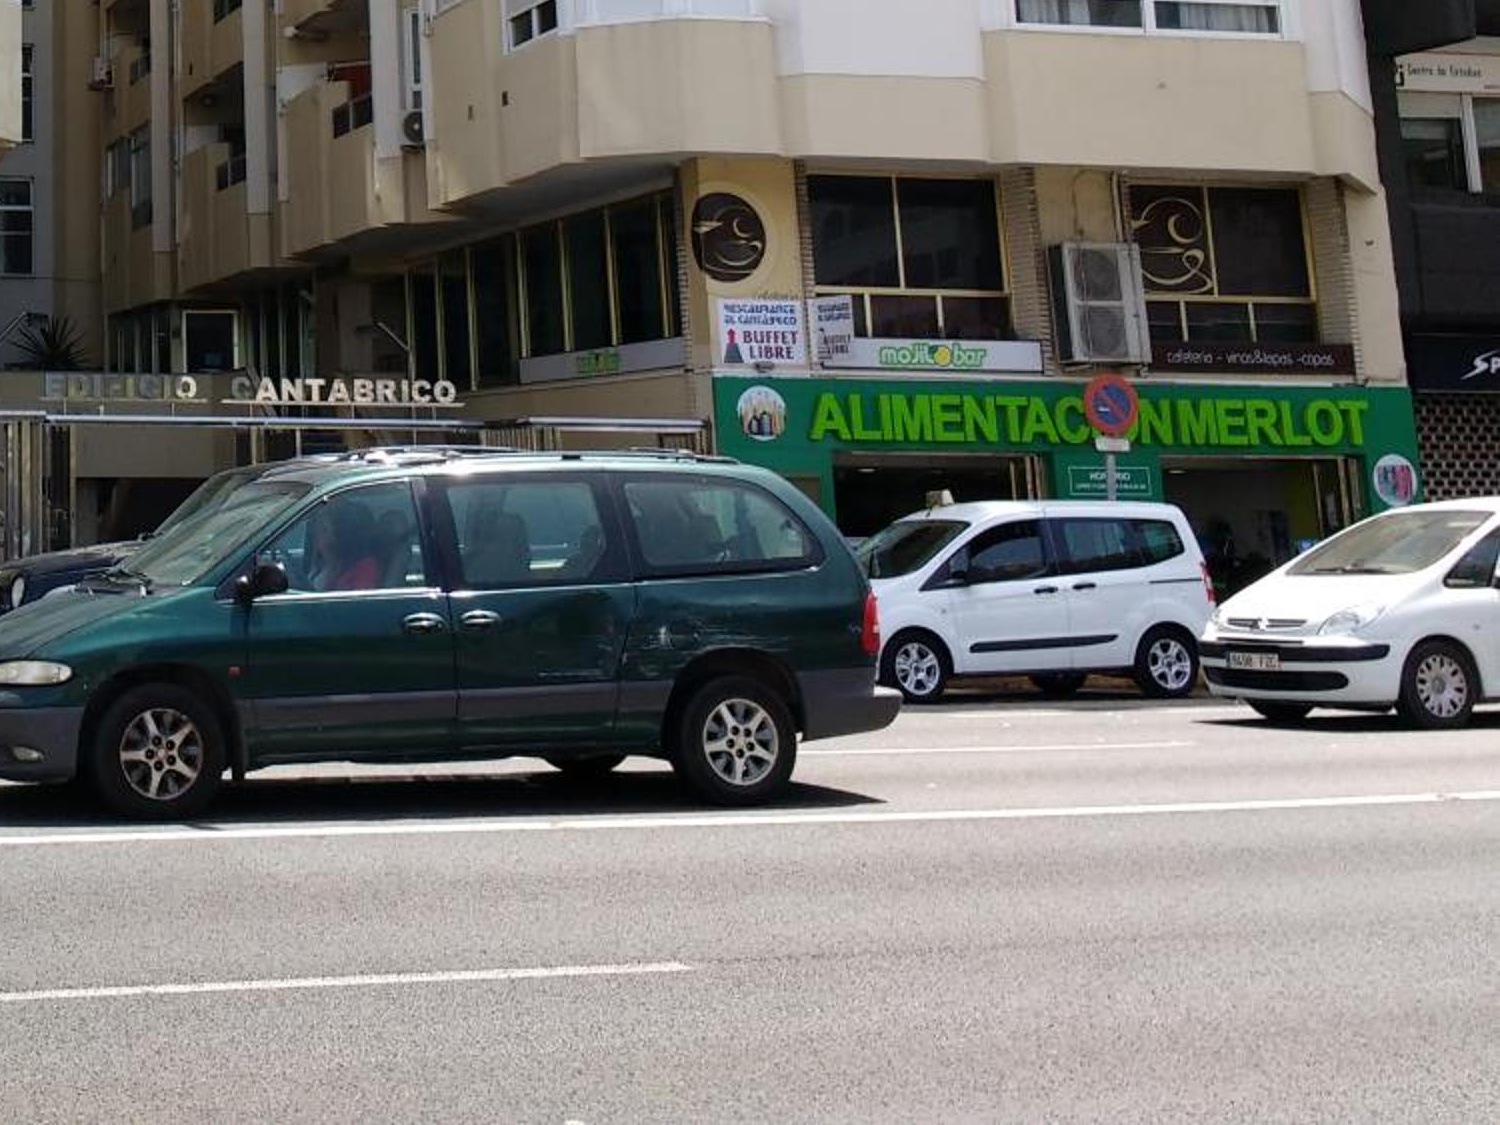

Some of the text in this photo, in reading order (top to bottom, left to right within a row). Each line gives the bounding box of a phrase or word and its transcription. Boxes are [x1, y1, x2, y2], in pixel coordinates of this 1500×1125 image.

[743, 330, 798, 345] BUFFET
[749, 345, 795, 360] LIBRE
[952, 342, 987, 367] bar
[44, 376, 458, 404] EDIFICIO CANTABRICO
[810, 392, 1368, 447] ALIMENTACN MERLOT
